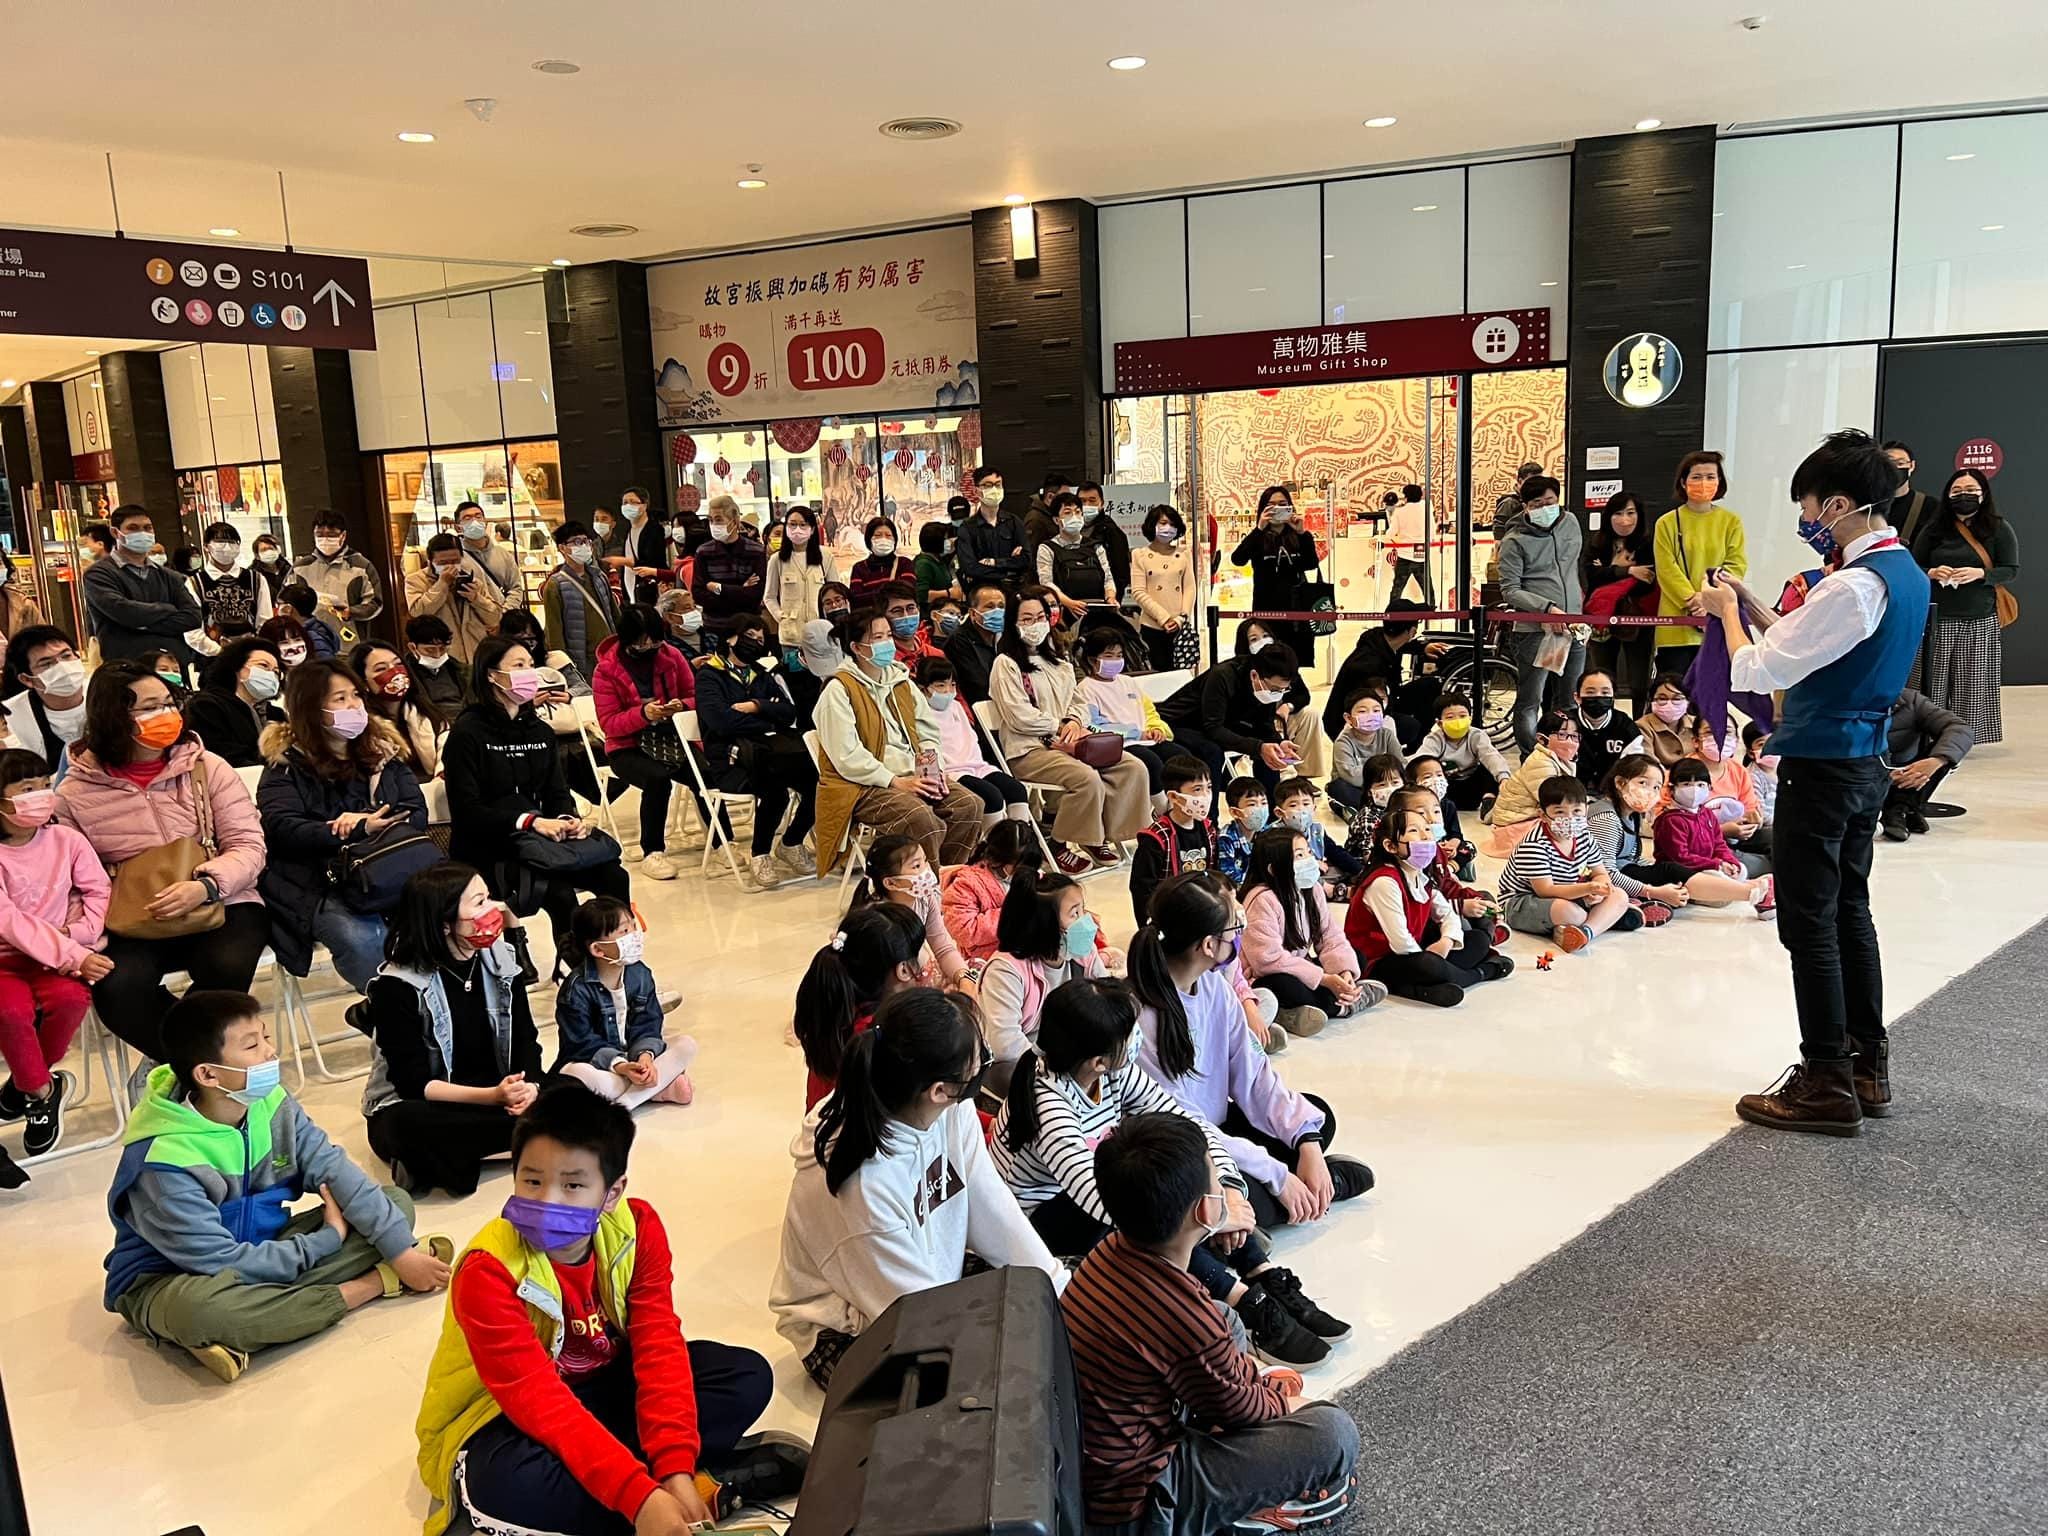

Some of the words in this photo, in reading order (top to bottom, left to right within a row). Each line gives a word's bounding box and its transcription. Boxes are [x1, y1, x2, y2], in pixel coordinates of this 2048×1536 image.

[18, 268, 46, 278] Plaza
[252, 269, 304, 291] S101
[704, 258, 925, 306] 故宮振興加碼有夠厲害
[699, 322, 726, 339] 購物
[1272, 330, 1368, 360] 萬物雅集
[719, 354, 740, 391] 9
[753, 372, 769, 390] 折
[802, 342, 867, 383] 100
[890, 355, 952, 378] 元抵用券
[1257, 363, 1313, 375] Museum
[1319, 358, 1346, 371] Gift
[1353, 357, 1389, 368] Shop
[1966, 444, 1993, 456] 1116
[1592, 484, 1617, 492] Wi-Fi
